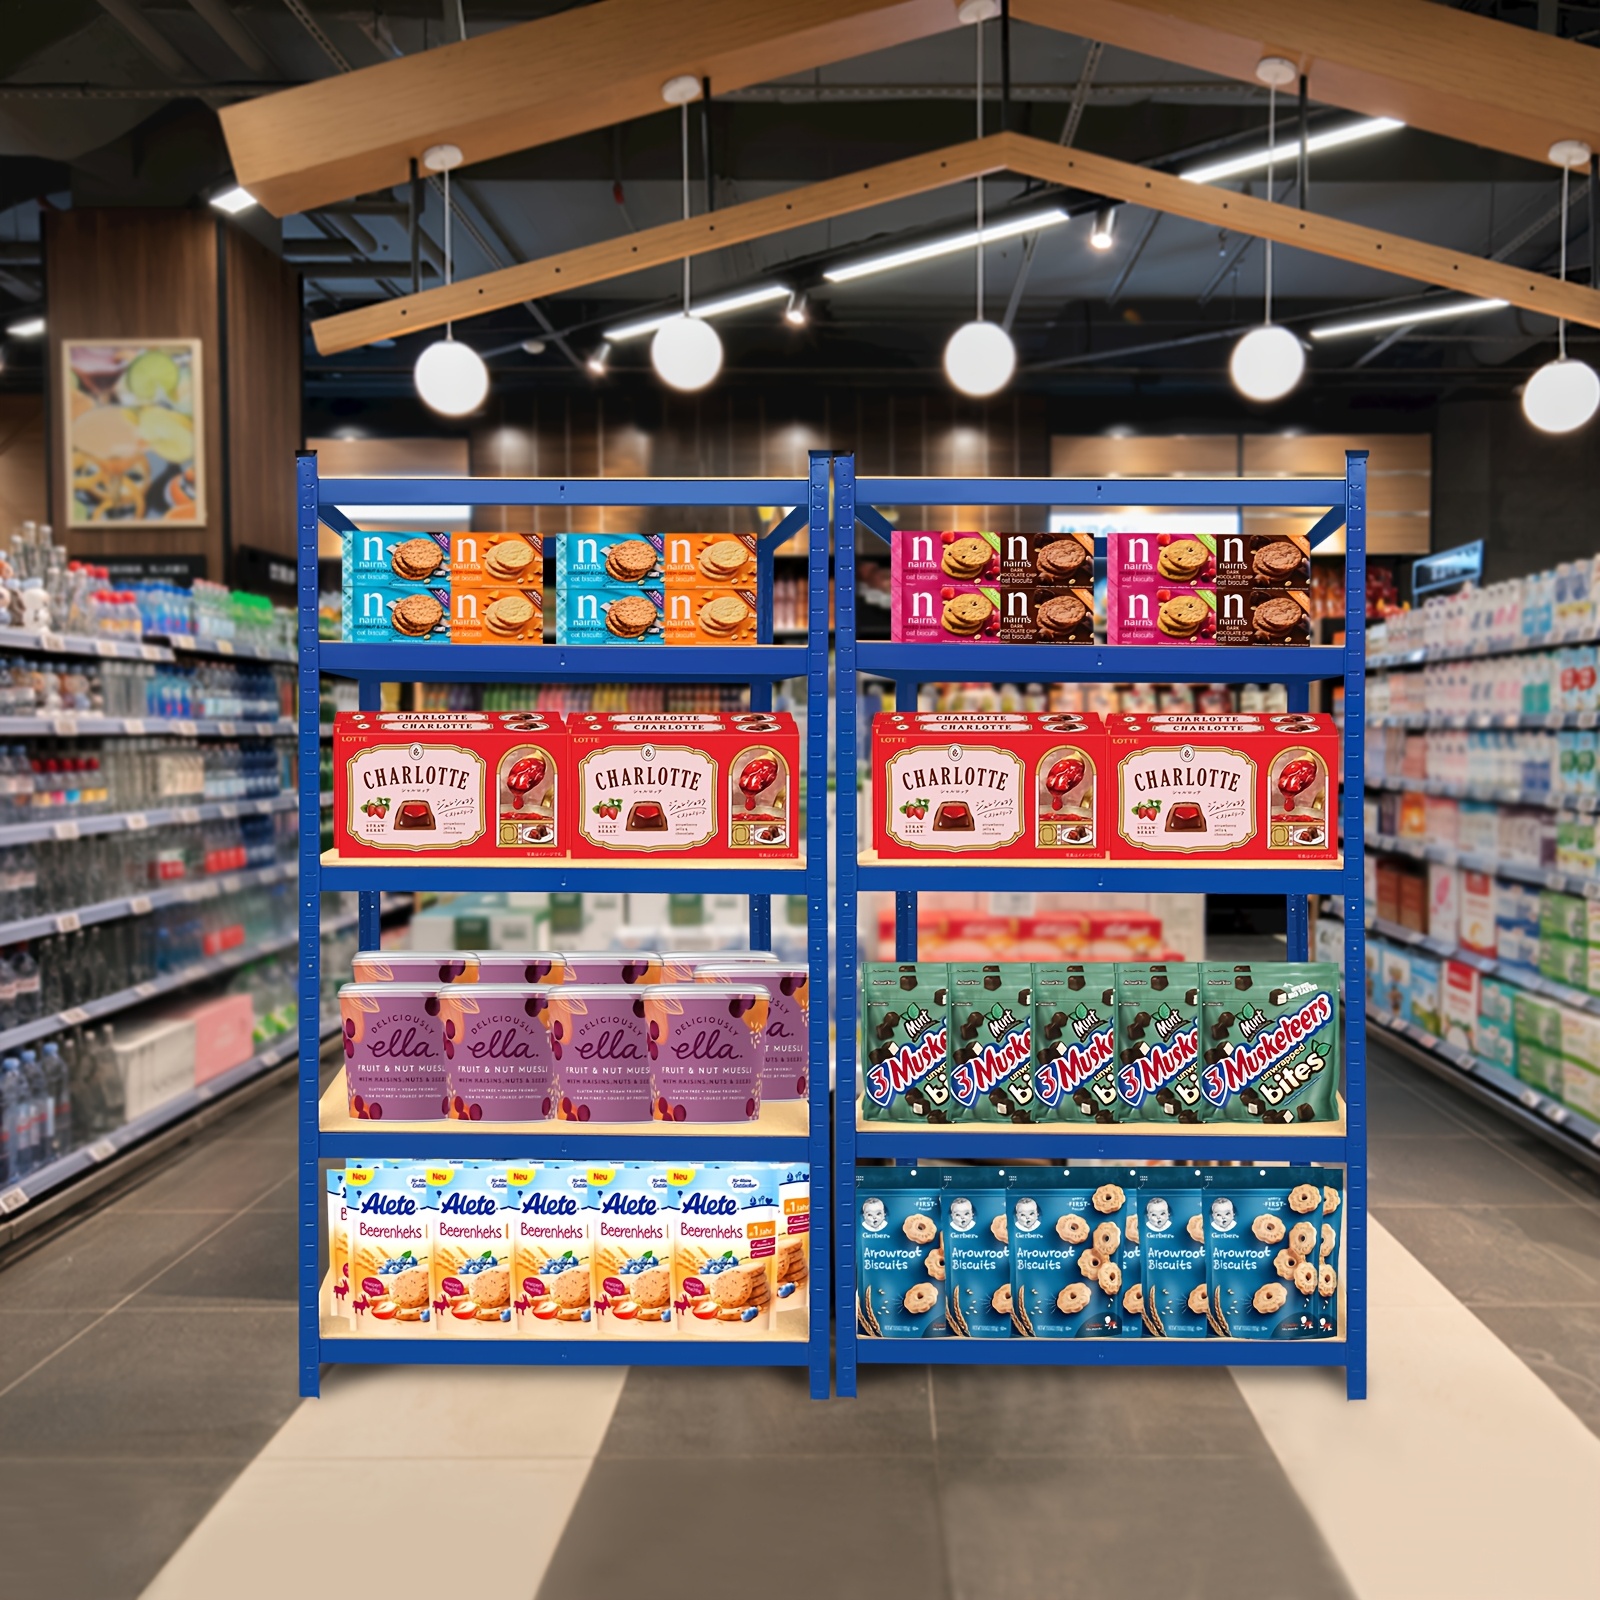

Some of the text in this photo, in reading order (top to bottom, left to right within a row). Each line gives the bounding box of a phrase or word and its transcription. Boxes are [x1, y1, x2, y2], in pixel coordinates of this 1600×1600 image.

[364, 766, 469, 790] CHARLOTTE
[596, 767, 701, 791] CHARLOTTE
[902, 767, 1008, 791] CHARLOTTE
[1134, 768, 1240, 792] CHARLOTTE
[371, 1014, 434, 1034] DELICIOUSLY
[471, 1015, 534, 1035] DELICIOUSLY
[579, 1016, 642, 1036] DELICIOUSLY
[675, 1016, 738, 1036] DELICIOUSLY
[904, 1010, 932, 1038] Mint
[988, 1010, 1016, 1038] Mint
[1072, 1010, 1100, 1038] Mint
[1156, 1010, 1184, 1038] Mint
[1240, 1010, 1268, 1038] Mint
[1205, 1069, 1224, 1097] 3
[1226, 996, 1328, 1089] Musketeers
[1261, 1043, 1306, 1082] unwrapped
[1261, 1054, 1324, 1106] bites
[361, 1192, 416, 1215] Alete
[441, 1192, 496, 1215] Alete
[522, 1192, 577, 1215] Alete
[602, 1192, 657, 1215] Alete
[682, 1192, 737, 1215] Alete
[791, 1202, 796, 1212] 1
[360, 1222, 422, 1239] Beerenkeks
[440, 1222, 502, 1239] Beerenkeks
[521, 1222, 583, 1239] Beerenkeks
[601, 1222, 663, 1239] Beerenkeks
[681, 1222, 743, 1239] Beerenkeks
[753, 1226, 758, 1236] 1
[864, 1246, 922, 1259] Arrowroot
[952, 1246, 1010, 1259] Arrowroot
[1017, 1246, 1075, 1259] Arrowroot
[1148, 1246, 1206, 1259] Arrowroot
[1213, 1246, 1271, 1259] Arrowroot
[864, 1260, 908, 1270] Biscuits
[952, 1260, 996, 1270] Biscuits
[1017, 1260, 1060, 1270] Biscuits
[1148, 1260, 1192, 1270] Biscuits
[1213, 1260, 1256, 1270] Biscuits
